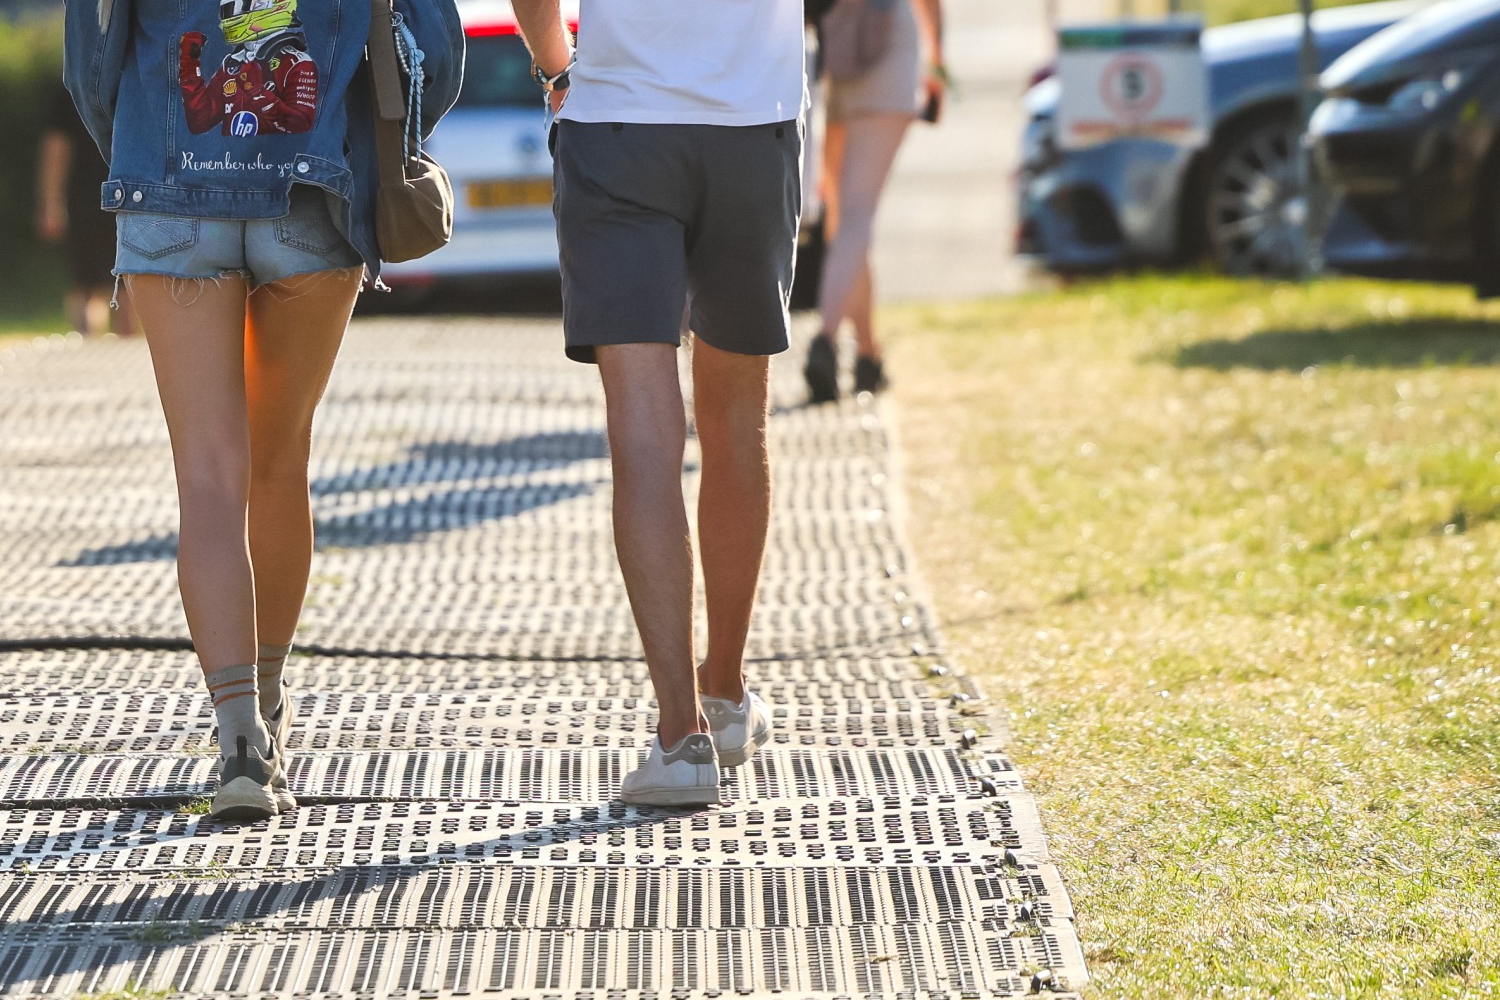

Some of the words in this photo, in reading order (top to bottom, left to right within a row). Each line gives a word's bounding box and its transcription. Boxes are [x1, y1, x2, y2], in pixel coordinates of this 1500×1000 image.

[235, 112, 253, 138] hp
[181, 151, 244, 172] Remember
[247, 152, 273, 171] who
